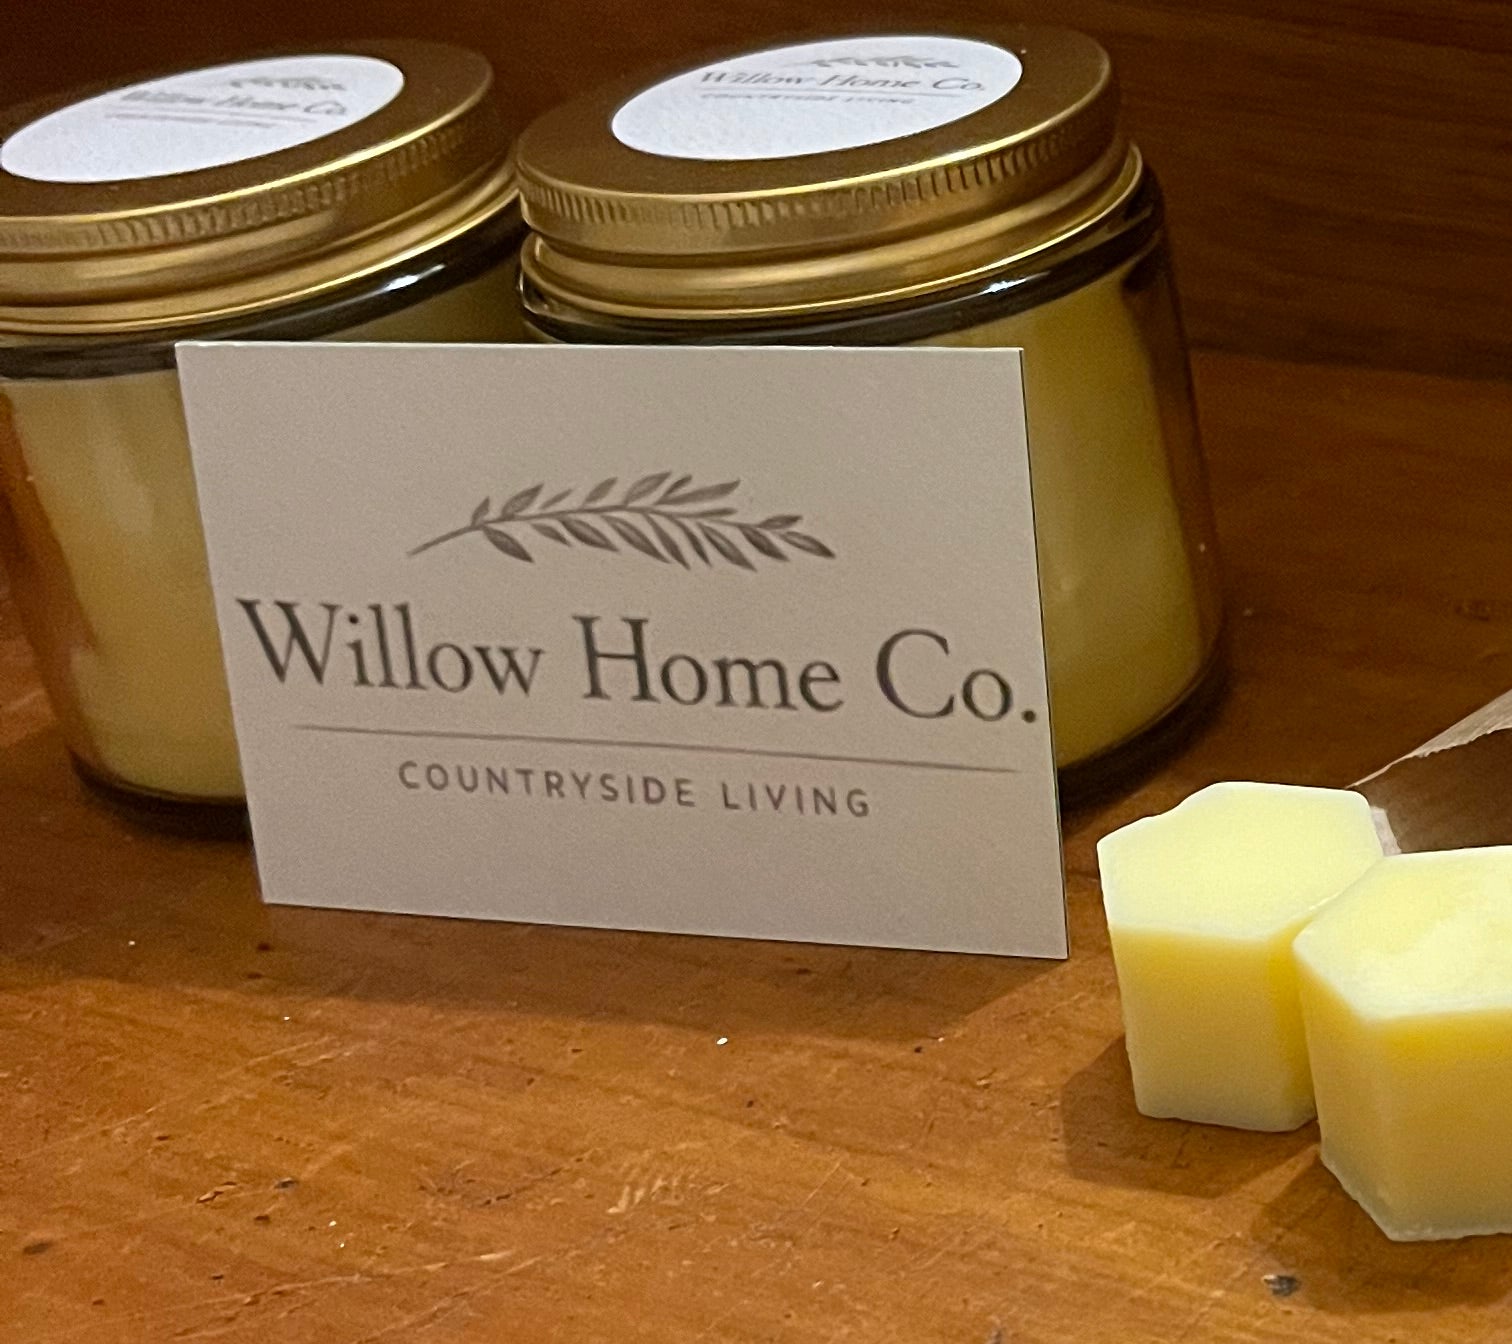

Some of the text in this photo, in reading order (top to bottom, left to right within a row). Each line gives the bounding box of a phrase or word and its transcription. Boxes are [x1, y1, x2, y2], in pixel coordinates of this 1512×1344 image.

[819, 74, 921, 88] Home
[235, 596, 1037, 724] Willow Home Co.
[398, 760, 871, 818] COUNTRYSIDE LIVING
